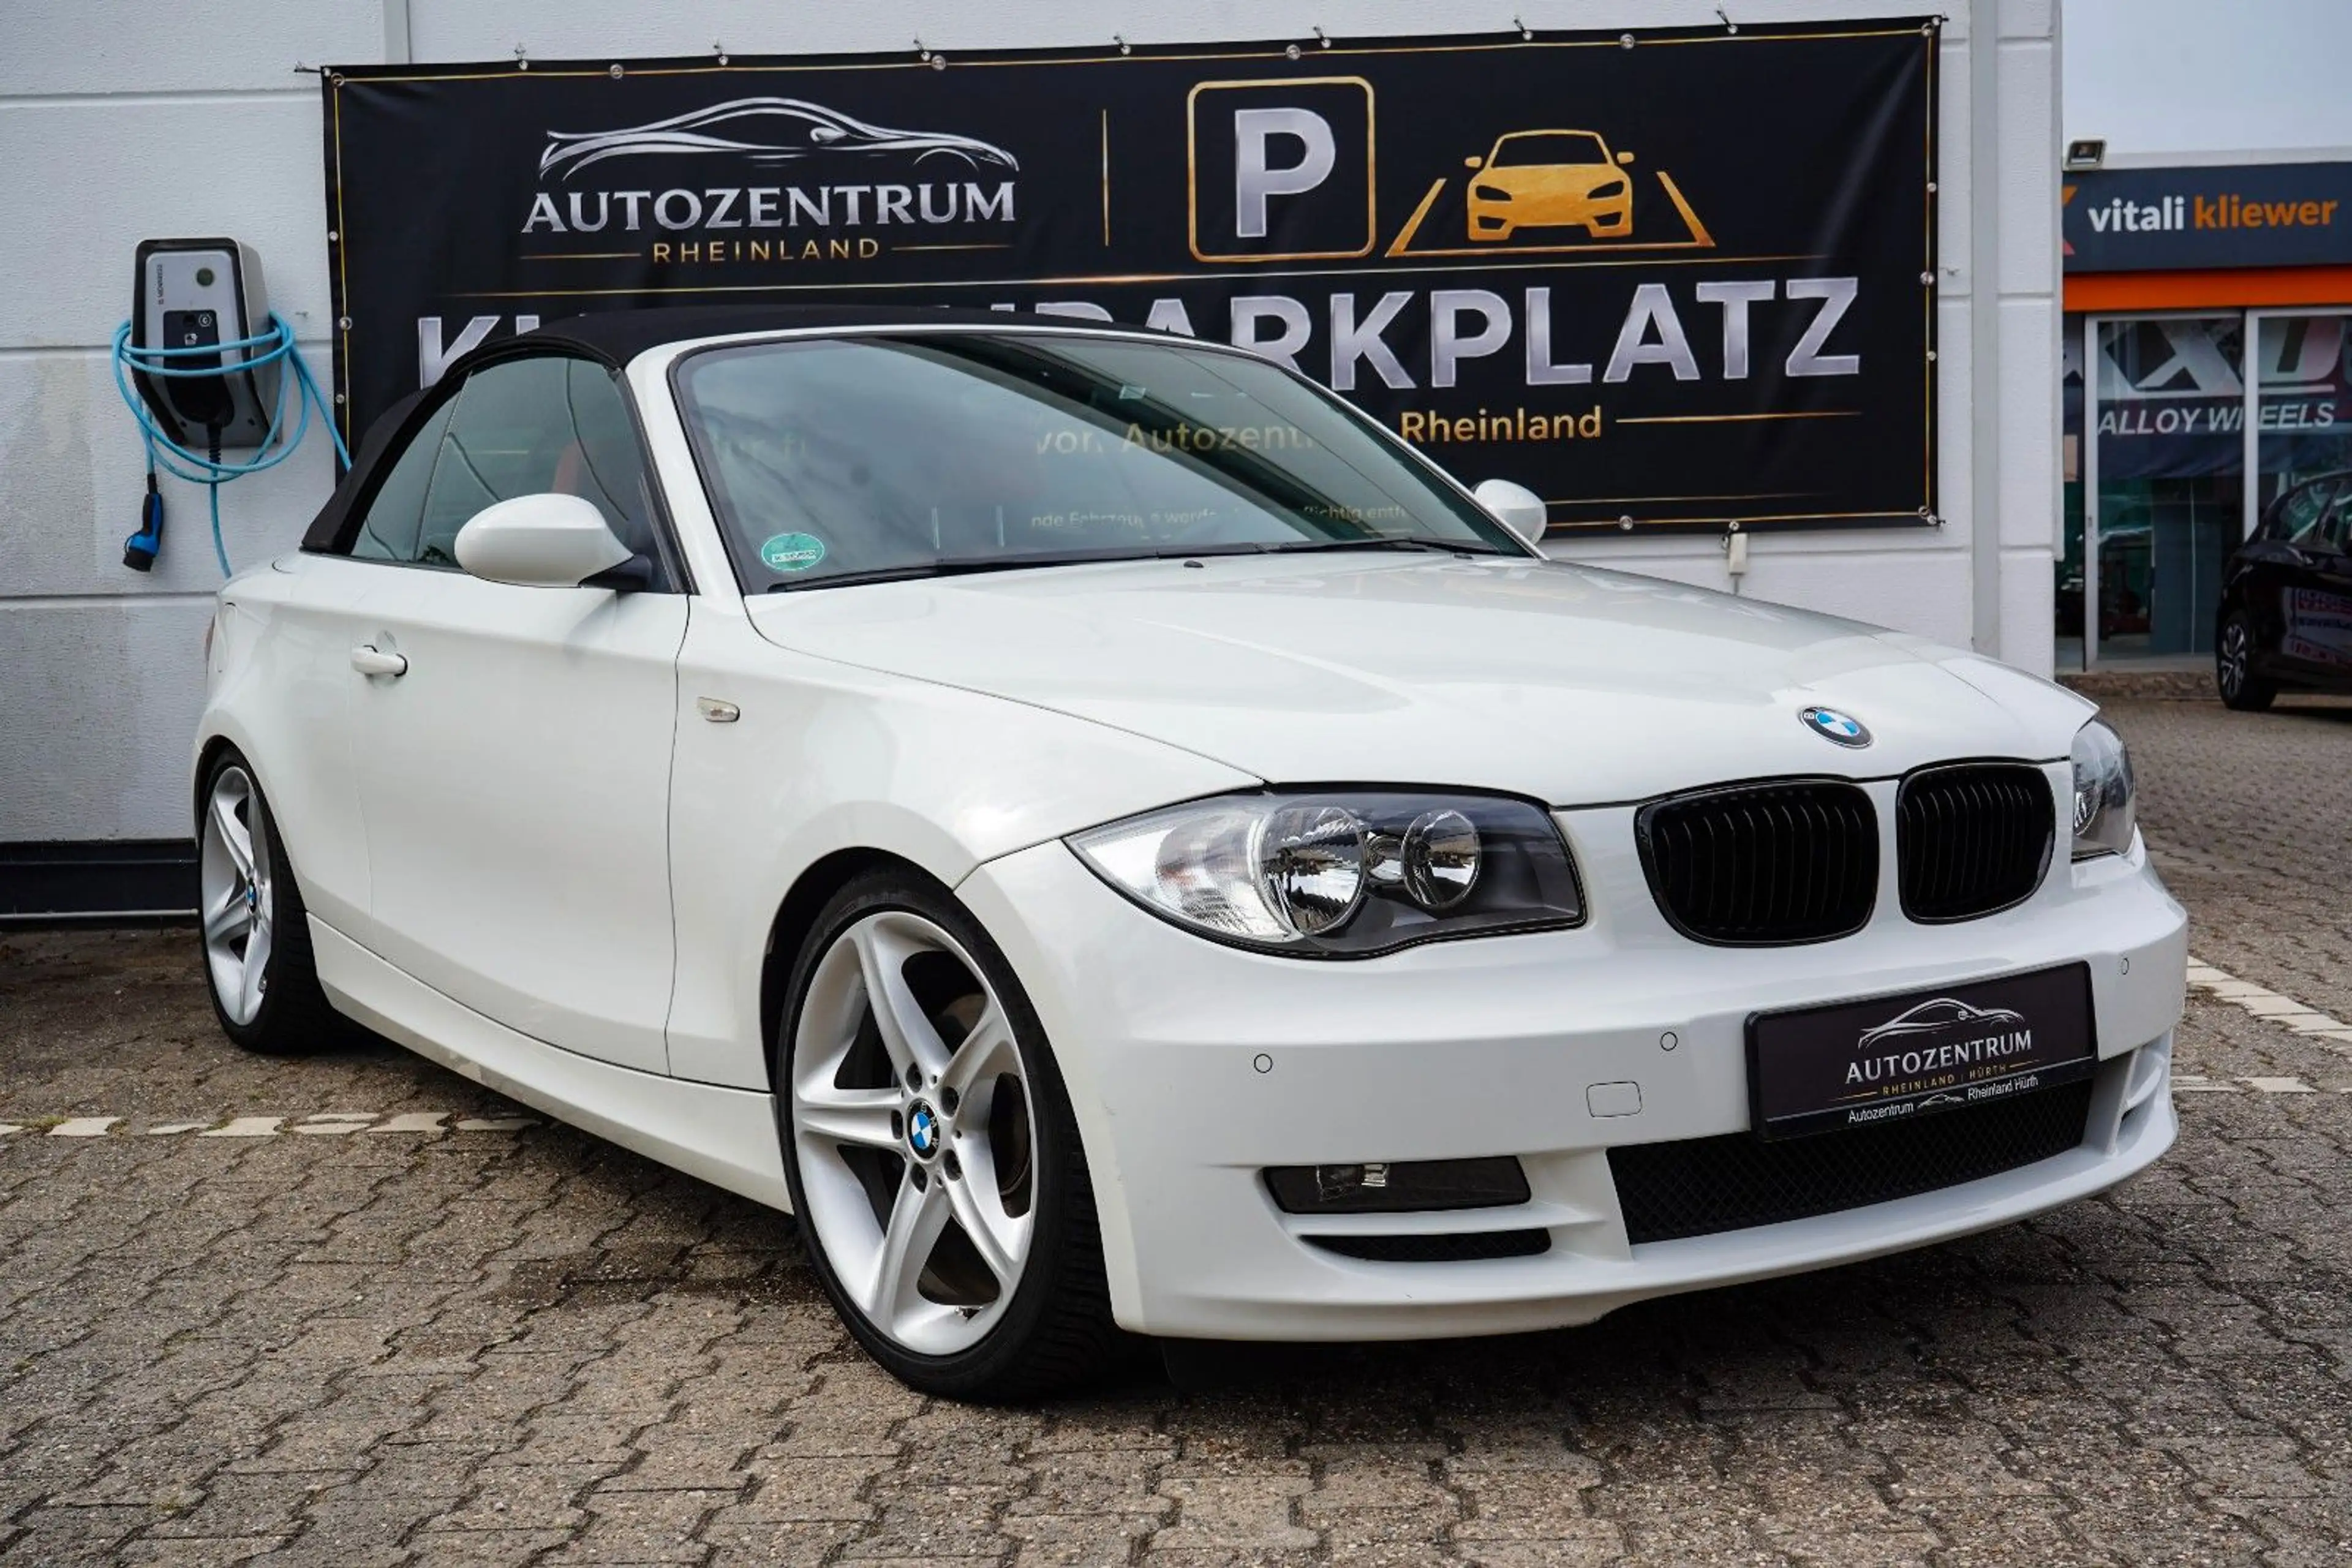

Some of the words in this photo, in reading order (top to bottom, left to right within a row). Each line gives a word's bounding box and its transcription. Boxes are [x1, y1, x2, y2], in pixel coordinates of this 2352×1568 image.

[1234, 107, 1336, 238] P
[521, 181, 1016, 235] AUTOZENTRUM
[2088, 195, 2185, 233] vitali
[2194, 194, 2338, 230] kliewer
[652, 238, 879, 263] RHEINLAND
[1400, 404, 1602, 444] Rheinland
[2098, 407, 2201, 435] ALLOY
[1845, 1029, 2033, 1085] AUTOZENTRUM
[1847, 1102, 1914, 1123] Autozentrum
[1967, 1080, 2013, 1100] Rheinland
[2014, 1074, 2039, 1092] Hürth
[1882, 1074, 1956, 1096] RHEINLAND
